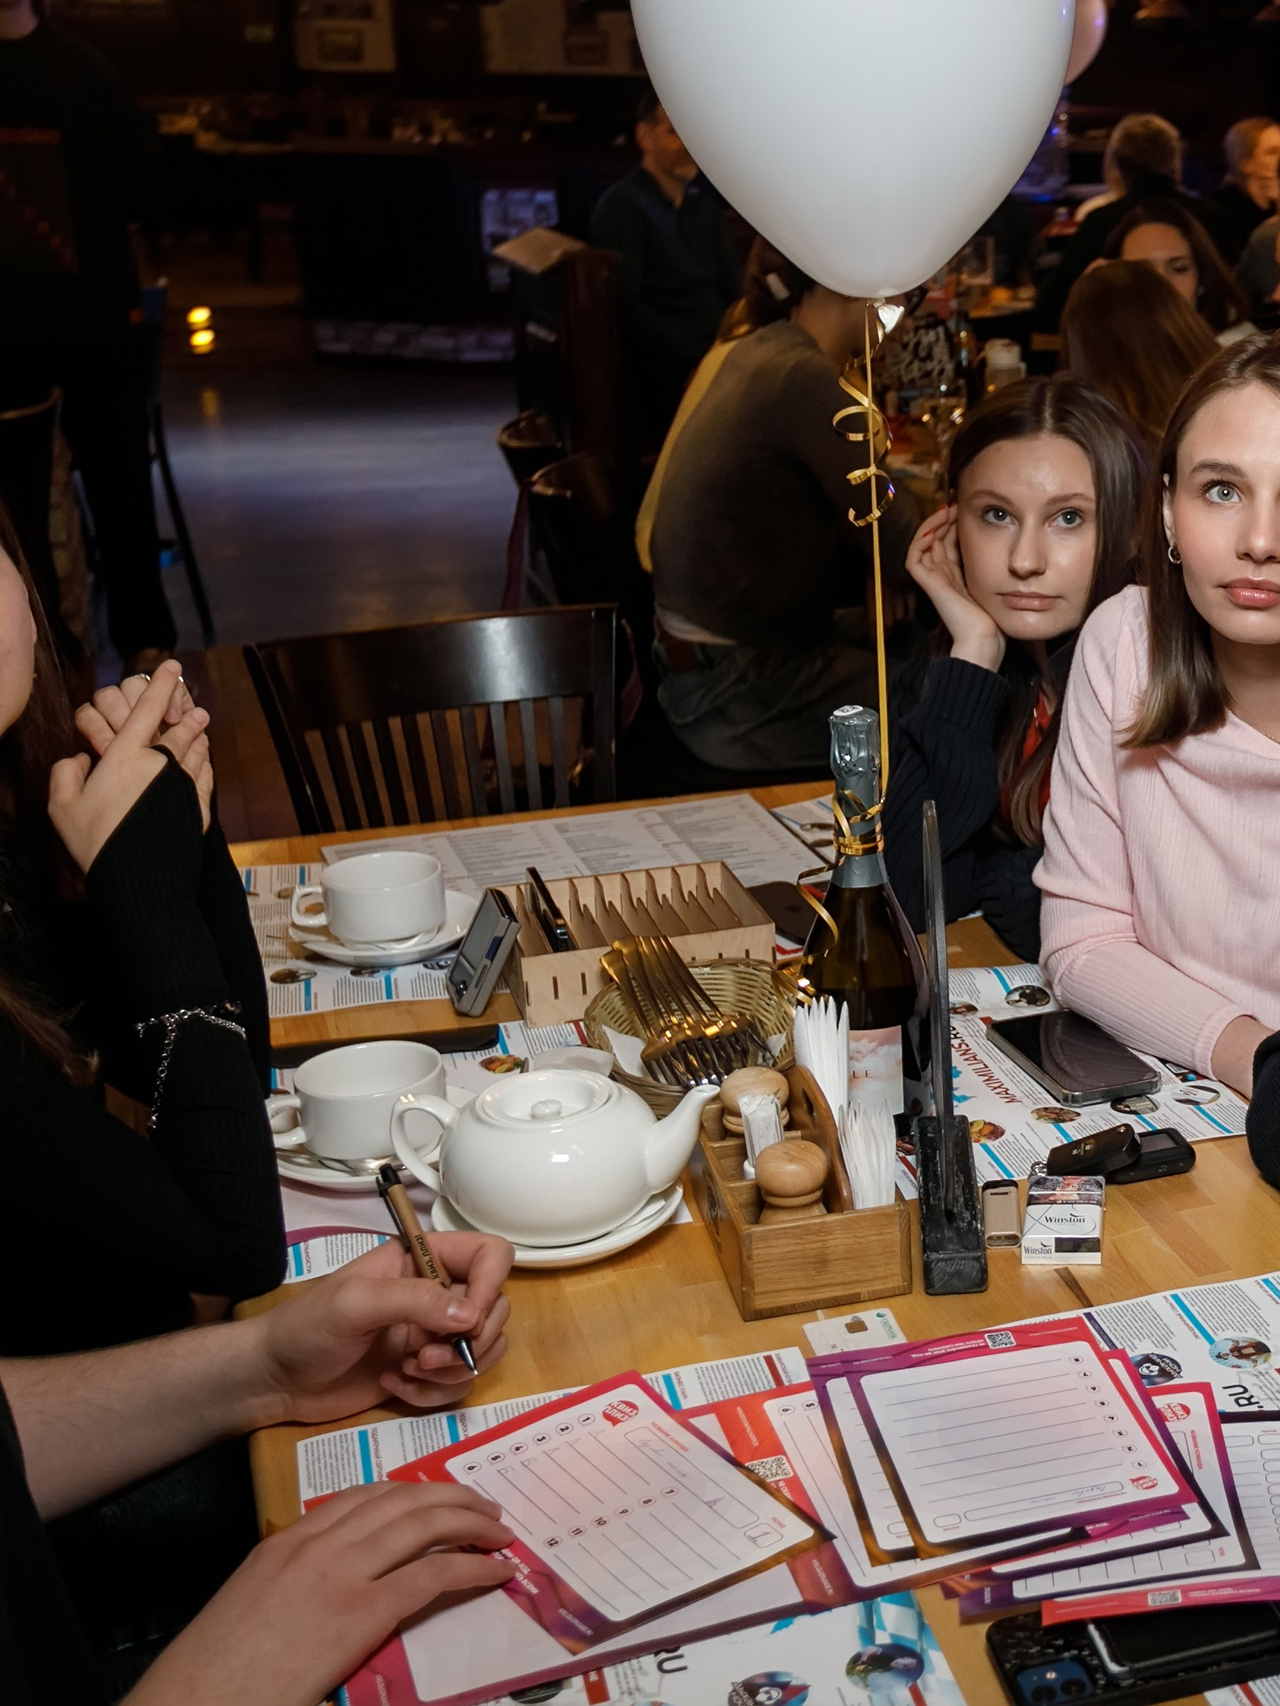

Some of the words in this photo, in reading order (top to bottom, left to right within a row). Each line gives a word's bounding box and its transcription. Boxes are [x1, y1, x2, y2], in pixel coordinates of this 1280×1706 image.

[1044, 1215, 1086, 1224] Winston
[1024, 1245, 1052, 1256] Winston
[304, 1240, 312, 1274] ЛЬНОСТИ
